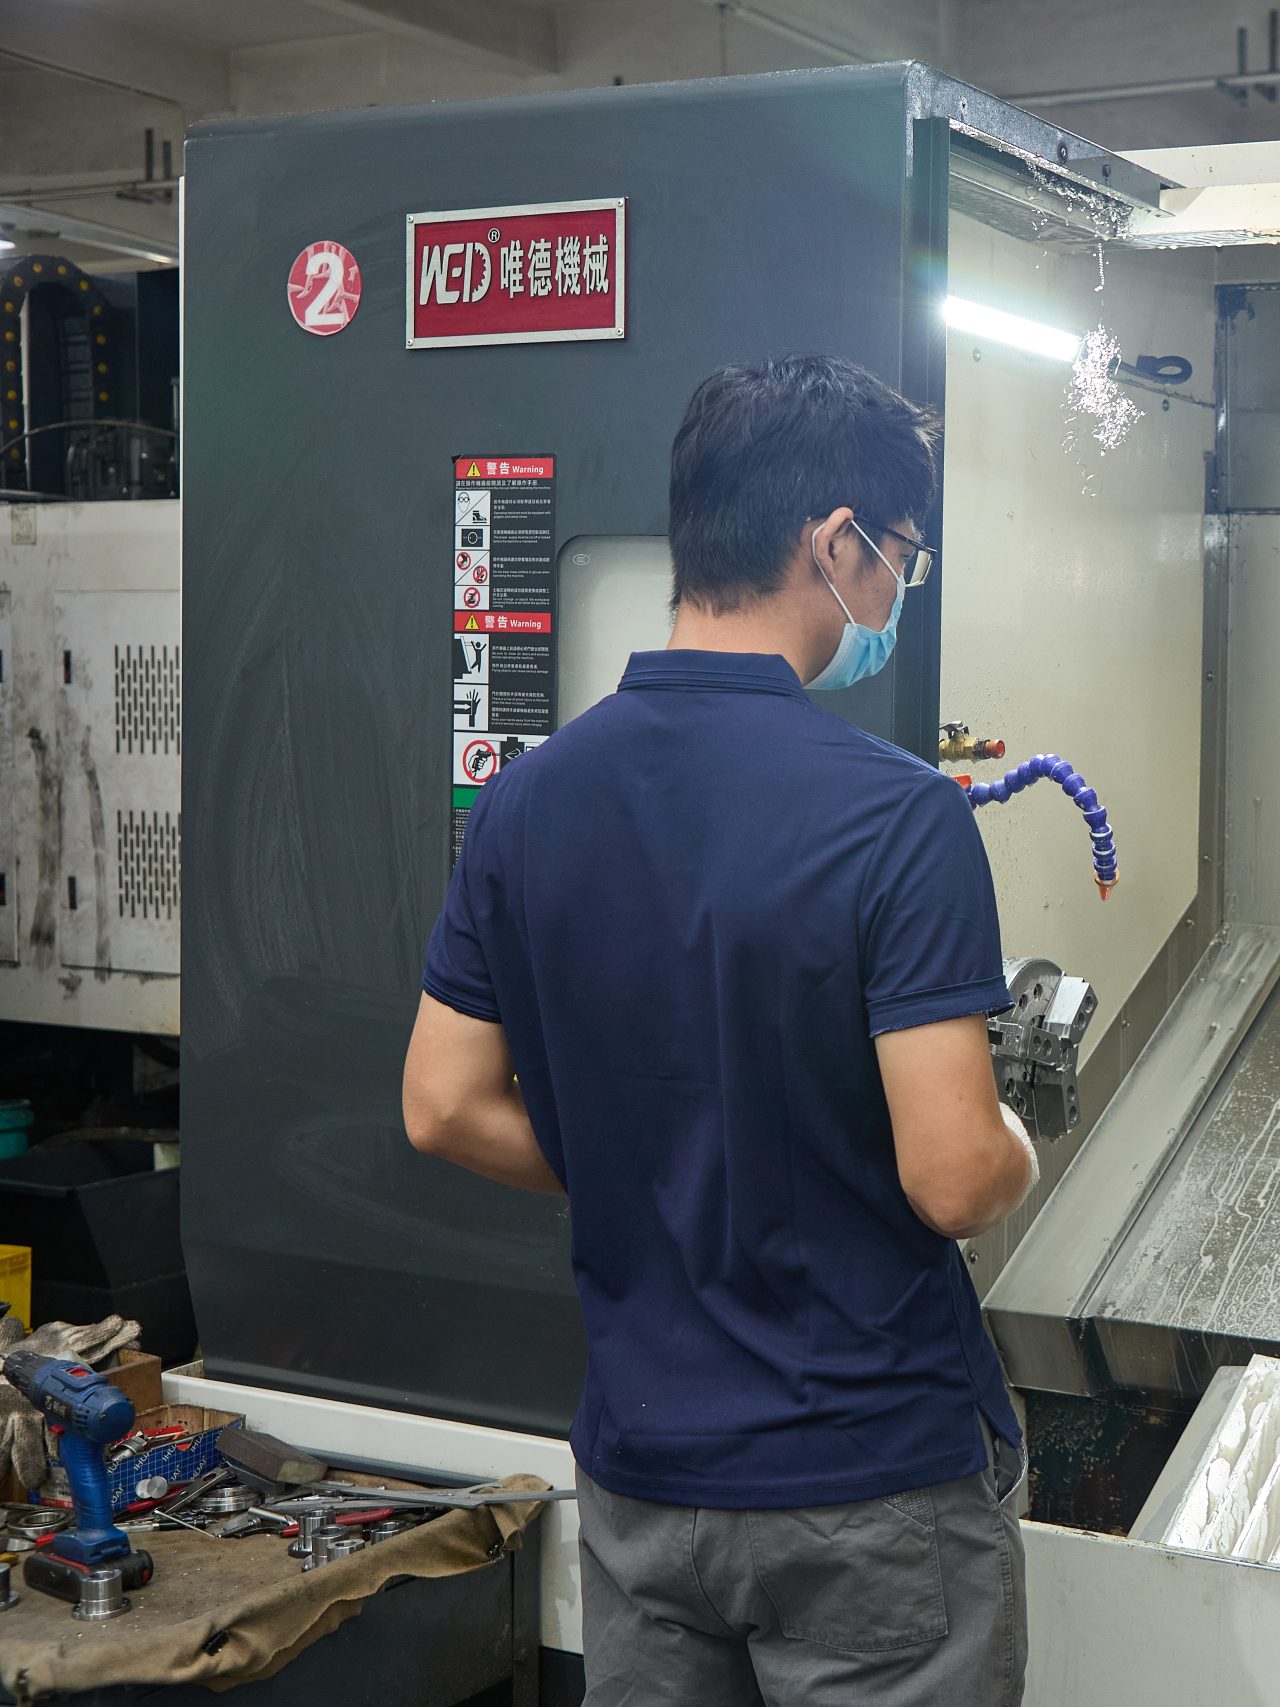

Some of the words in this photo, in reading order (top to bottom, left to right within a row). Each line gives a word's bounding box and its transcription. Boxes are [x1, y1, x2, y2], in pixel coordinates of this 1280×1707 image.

[500, 234, 608, 298] 唯德機械
[304, 252, 346, 325] 2
[487, 462, 510, 475] 警告
[512, 466, 544, 475] Warning
[485, 616, 508, 629] 警告
[510, 619, 542, 630] Warning
